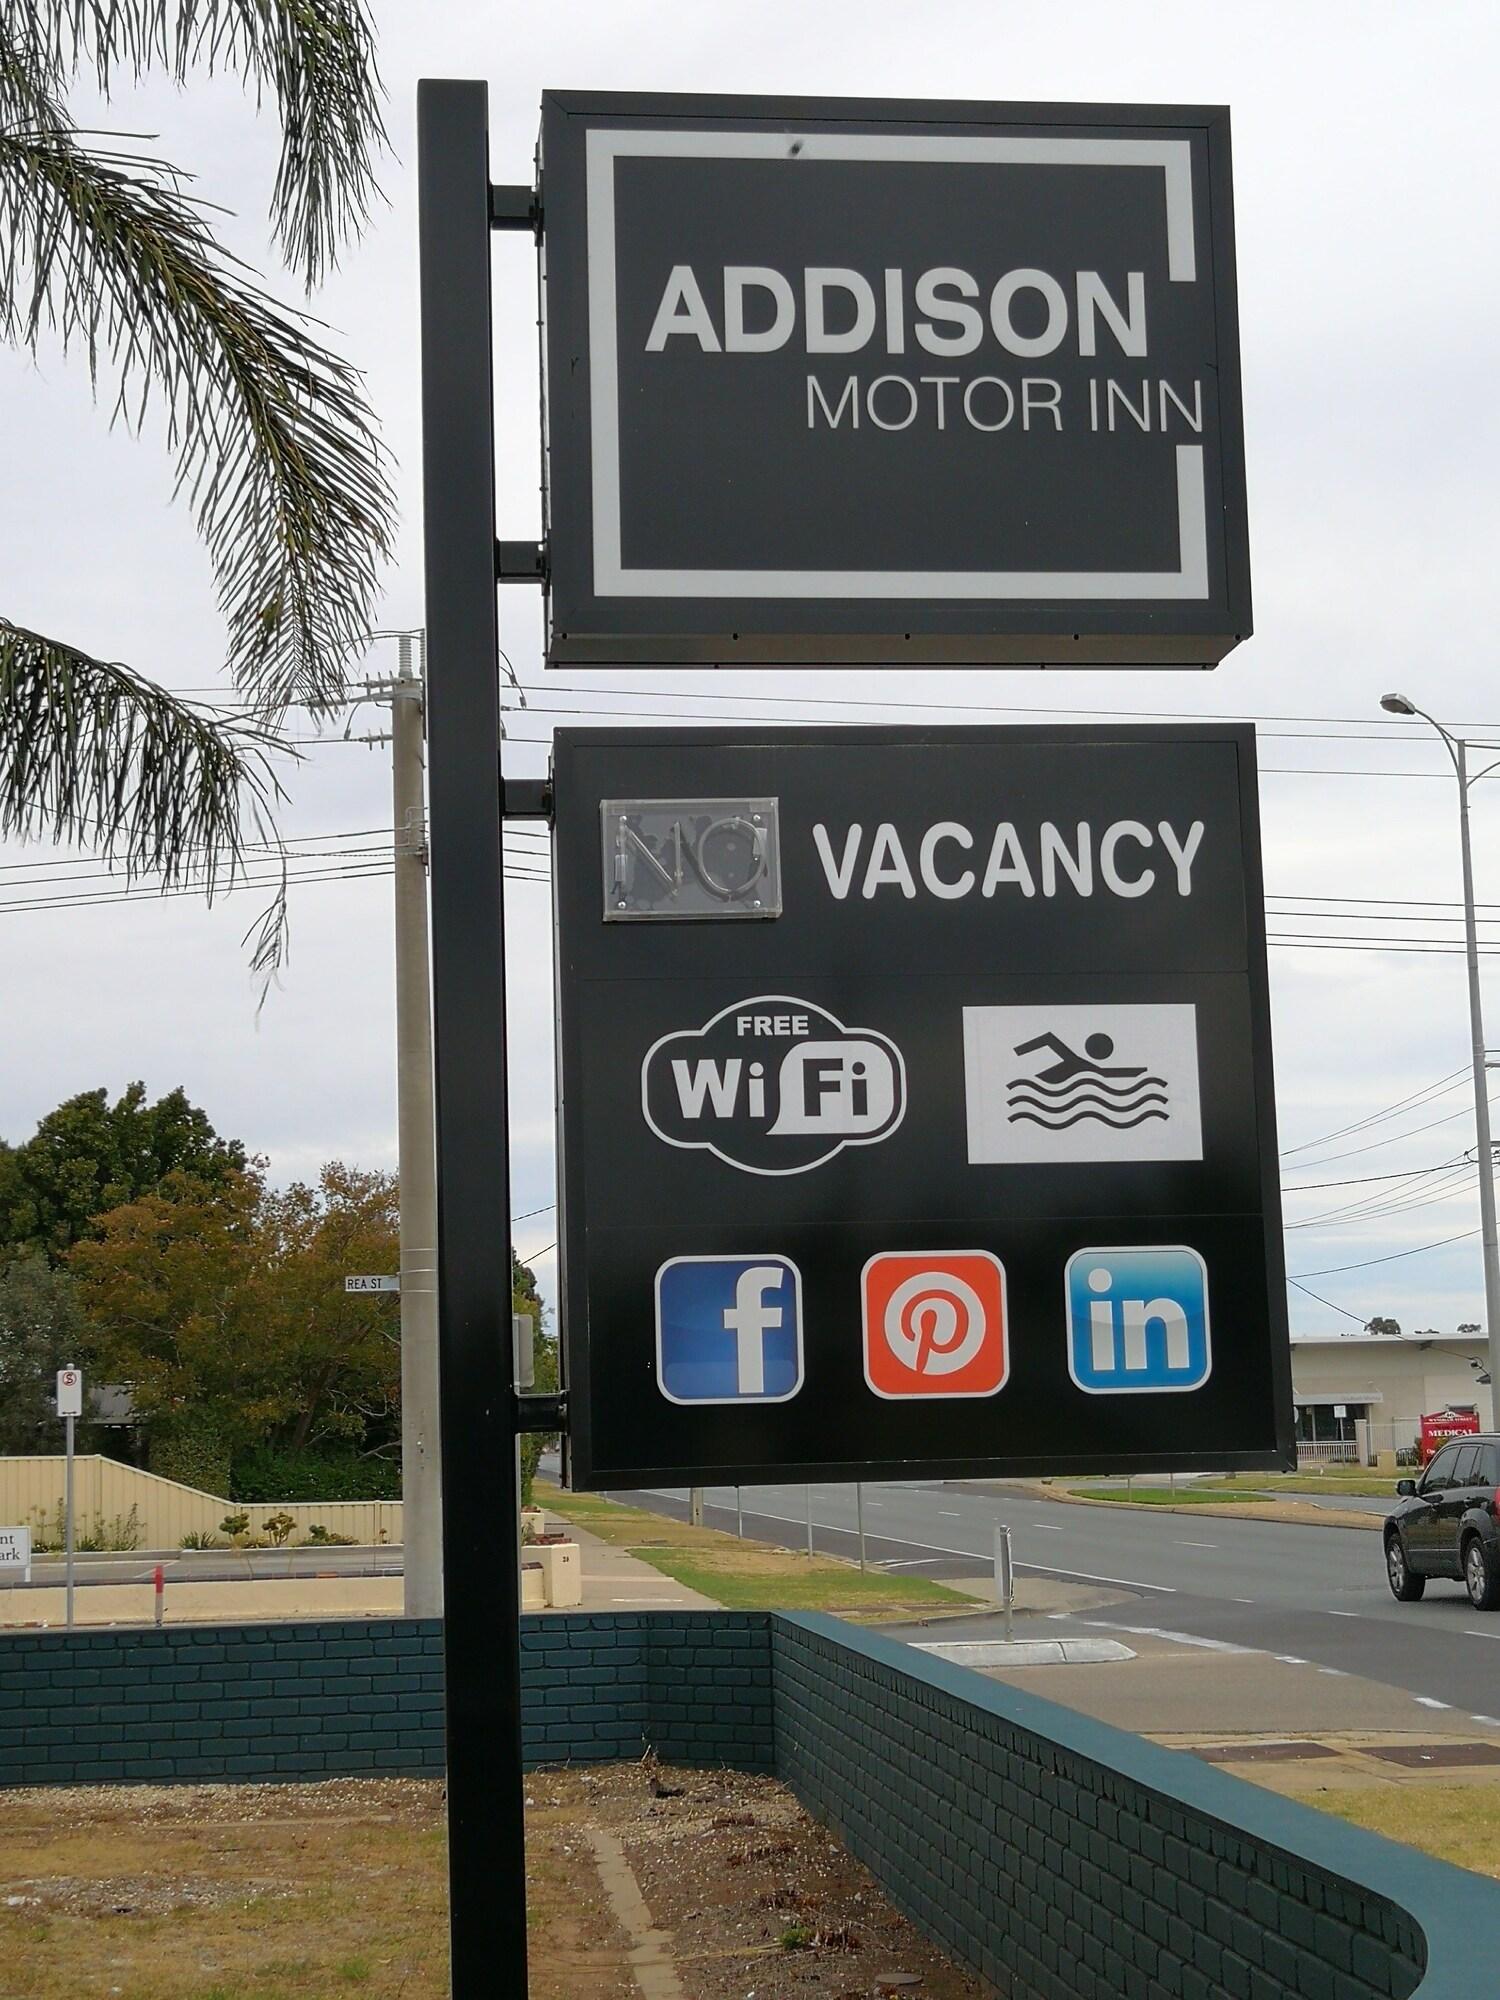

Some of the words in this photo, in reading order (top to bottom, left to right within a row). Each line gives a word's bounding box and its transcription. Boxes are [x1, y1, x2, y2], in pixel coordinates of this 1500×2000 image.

[645, 265, 1148, 358] ADDISON
[806, 374, 1064, 432] MOTOR
[1090, 378, 1204, 433] INN
[616, 816, 767, 898] NO
[812, 820, 1206, 901] VACANCY
[737, 1015, 809, 1036] FREE
[347, 1278, 368, 1290] REA
[370, 1277, 382, 1289] ST
[1087, 1268, 1190, 1371] in
